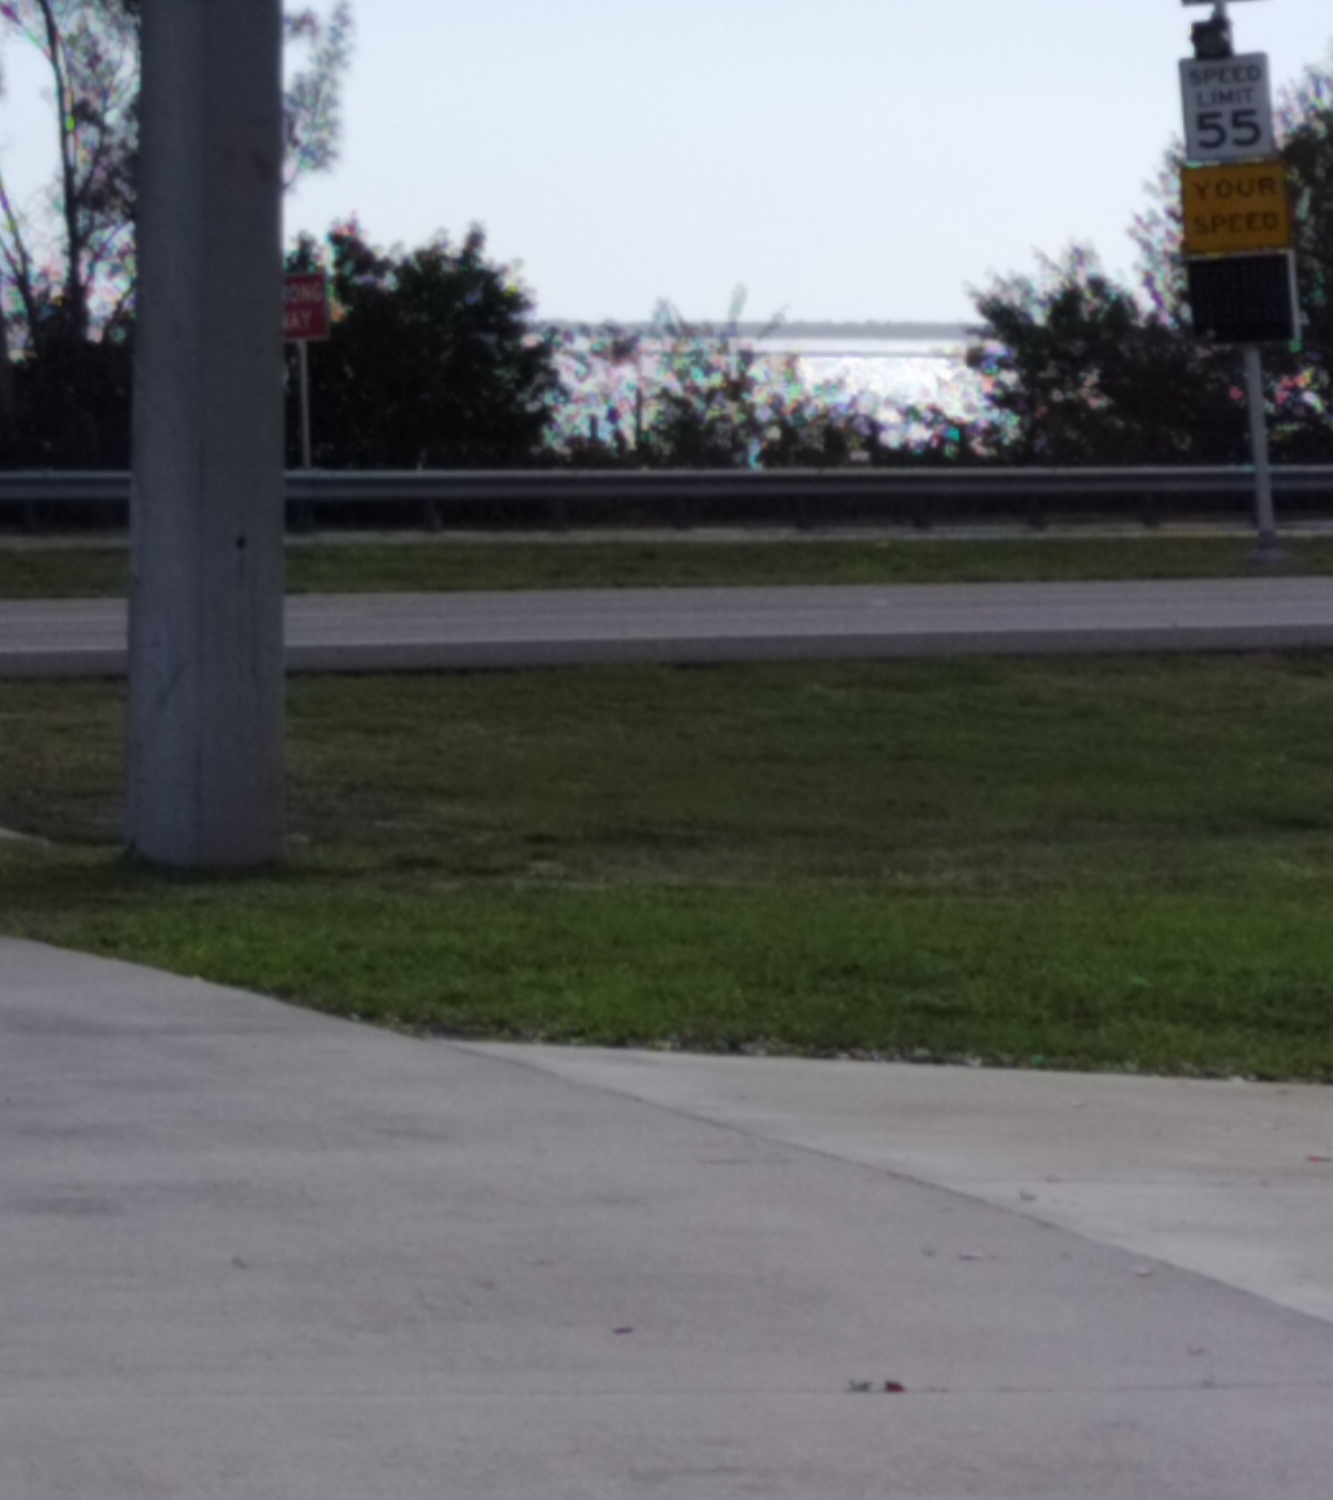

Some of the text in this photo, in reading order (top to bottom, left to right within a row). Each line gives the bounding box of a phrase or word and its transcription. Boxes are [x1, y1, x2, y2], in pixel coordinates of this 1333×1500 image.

[1188, 65, 1262, 86] SPEED
[1196, 88, 1254, 108] LIMIT
[1197, 109, 1262, 150] 55
[1192, 176, 1278, 201] YOUR
[1193, 211, 1280, 235] SPEED
[283, 282, 324, 303] ONG
